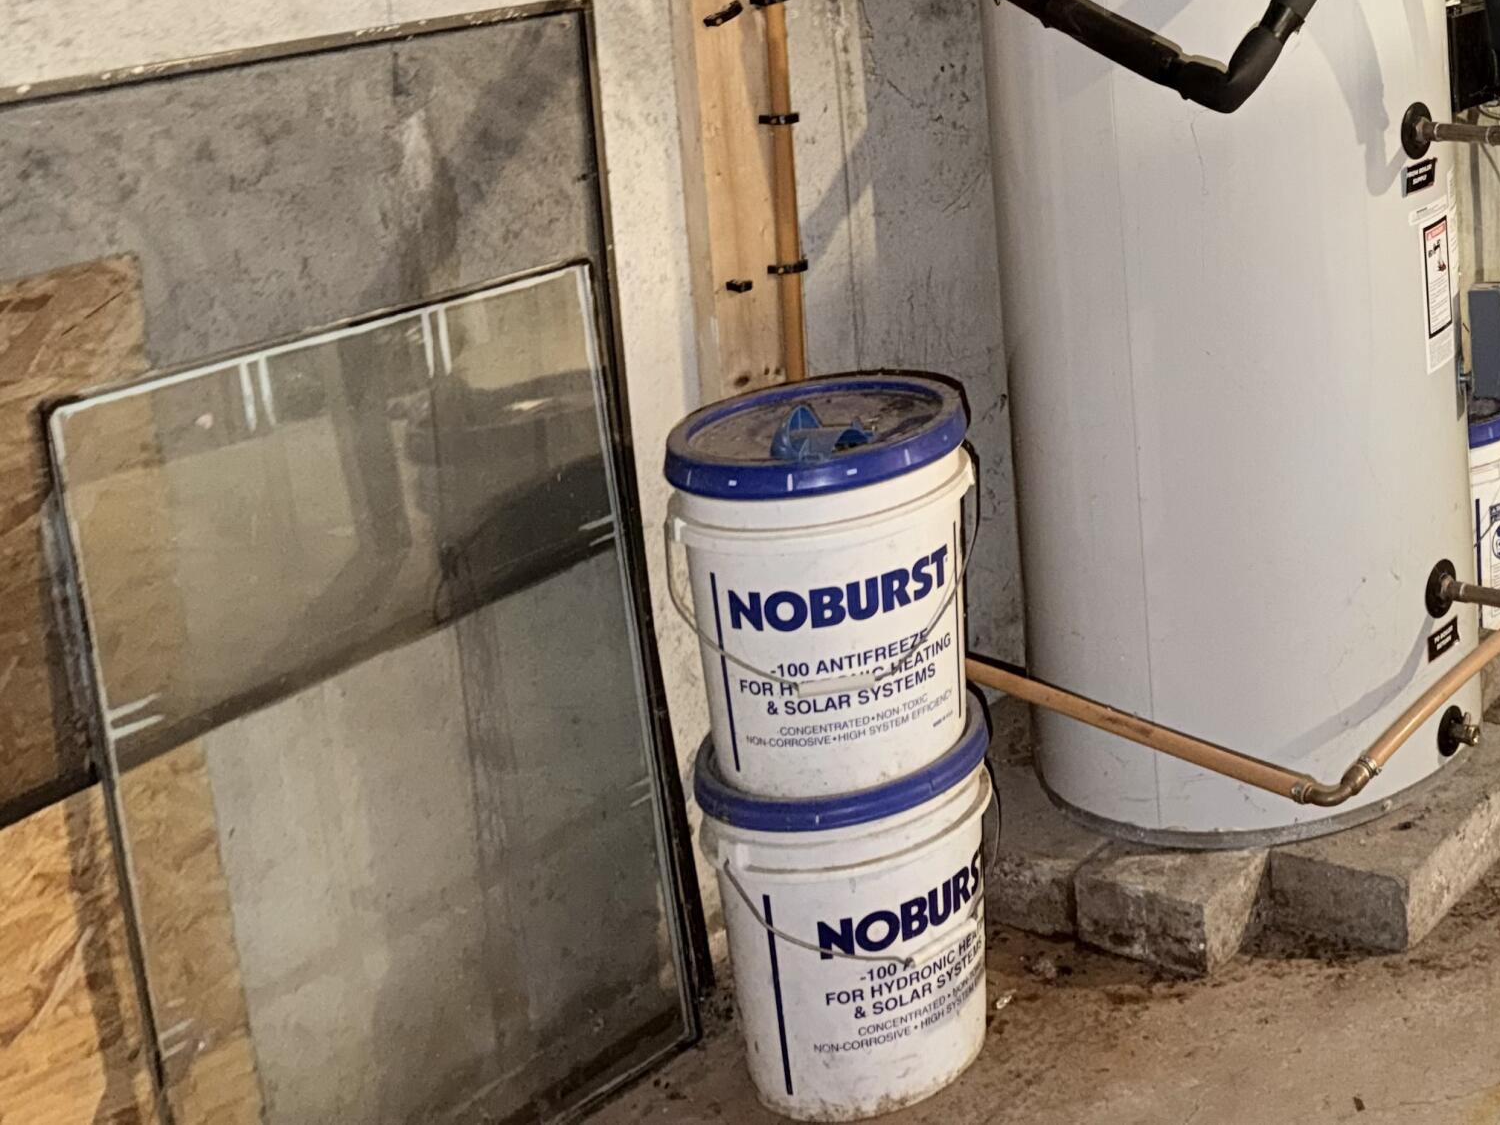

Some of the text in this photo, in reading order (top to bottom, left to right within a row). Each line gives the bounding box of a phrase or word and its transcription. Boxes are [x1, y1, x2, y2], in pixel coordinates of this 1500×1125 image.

[727, 543, 949, 633] NOBURST
[739, 679, 774, 697] FOR
[767, 702, 779, 716] &
[784, 694, 850, 716] SOLAR
[858, 662, 937, 705] SYSTEMS
[770, 662, 809, 678] -100
[817, 841, 982, 960] NOBURS
[825, 988, 864, 1006] FOR
[871, 950, 957, 999] HYDRONIC
[860, 962, 897, 982] -100
[854, 1005, 866, 1020] &
[873, 982, 933, 1016] SOLAR
[858, 995, 946, 1037] CONCENTRATED
[814, 1026, 912, 1054] NON-CORROSIVE
[920, 1008, 945, 1030] HIGH
